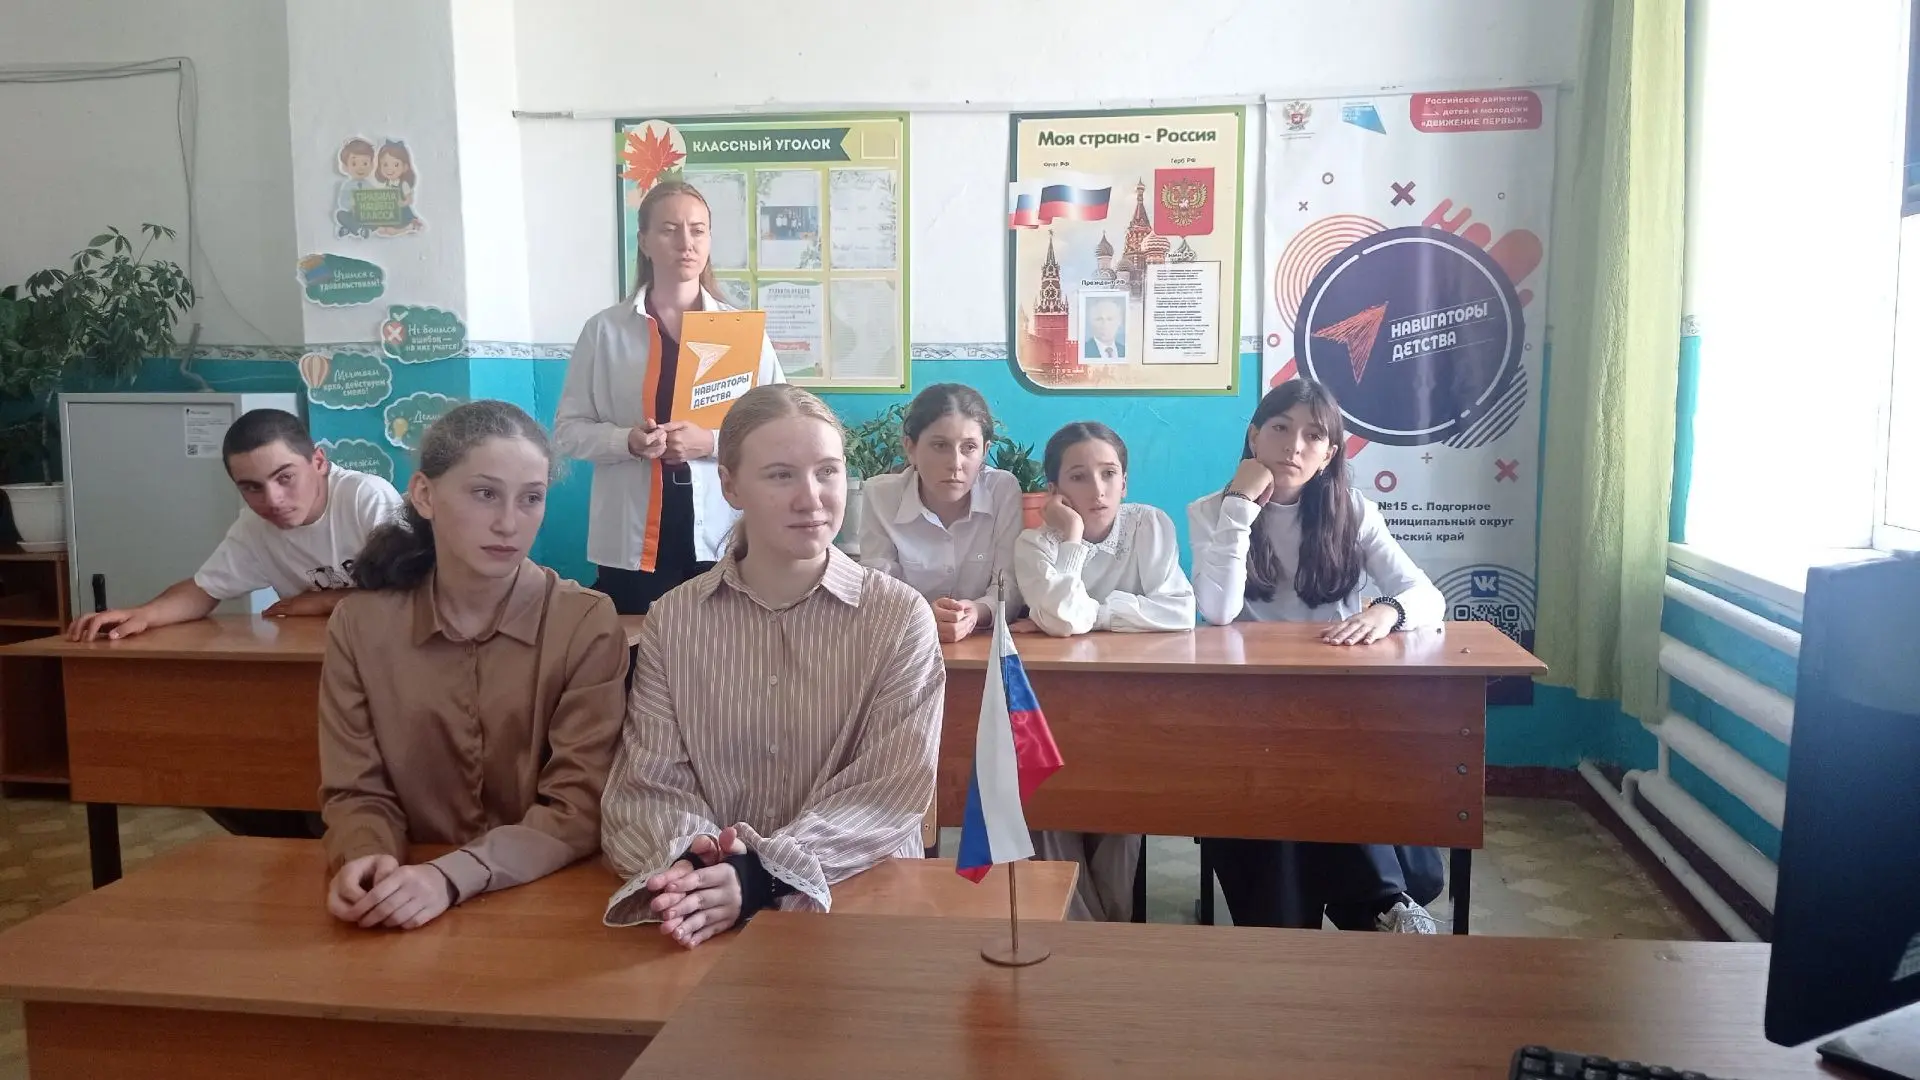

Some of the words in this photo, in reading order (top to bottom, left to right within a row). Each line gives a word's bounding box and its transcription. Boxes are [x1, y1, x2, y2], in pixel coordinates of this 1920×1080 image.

[1425, 97, 1480, 105] Российское
[1482, 95, 1529, 104] движение
[1421, 118, 1480, 128] «ДВИЖЕНИЕ
[1482, 118, 1529, 126] ПЕРВЫХ»
[692, 137, 772, 153] КЛАССНЫЙ
[775, 138, 831, 151] УГОЛОК
[1038, 131, 1075, 146] Моя
[1079, 133, 1139, 148] страна
[1156, 128, 1216, 143] Россия
[1391, 302, 1488, 338] НАВИГАТОРЫ
[1392, 331, 1457, 362] ДЕТСТВА
[694, 374, 749, 396] НАВИГАТОРЫ
[693, 390, 731, 409] ДЕТСТВА
[1378, 502, 1408, 511] №15
[1426, 502, 1491, 513] Подгорное
[1384, 517, 1476, 527] униципальный
[1480, 519, 1514, 528] округ
[1436, 532, 1465, 542] край
